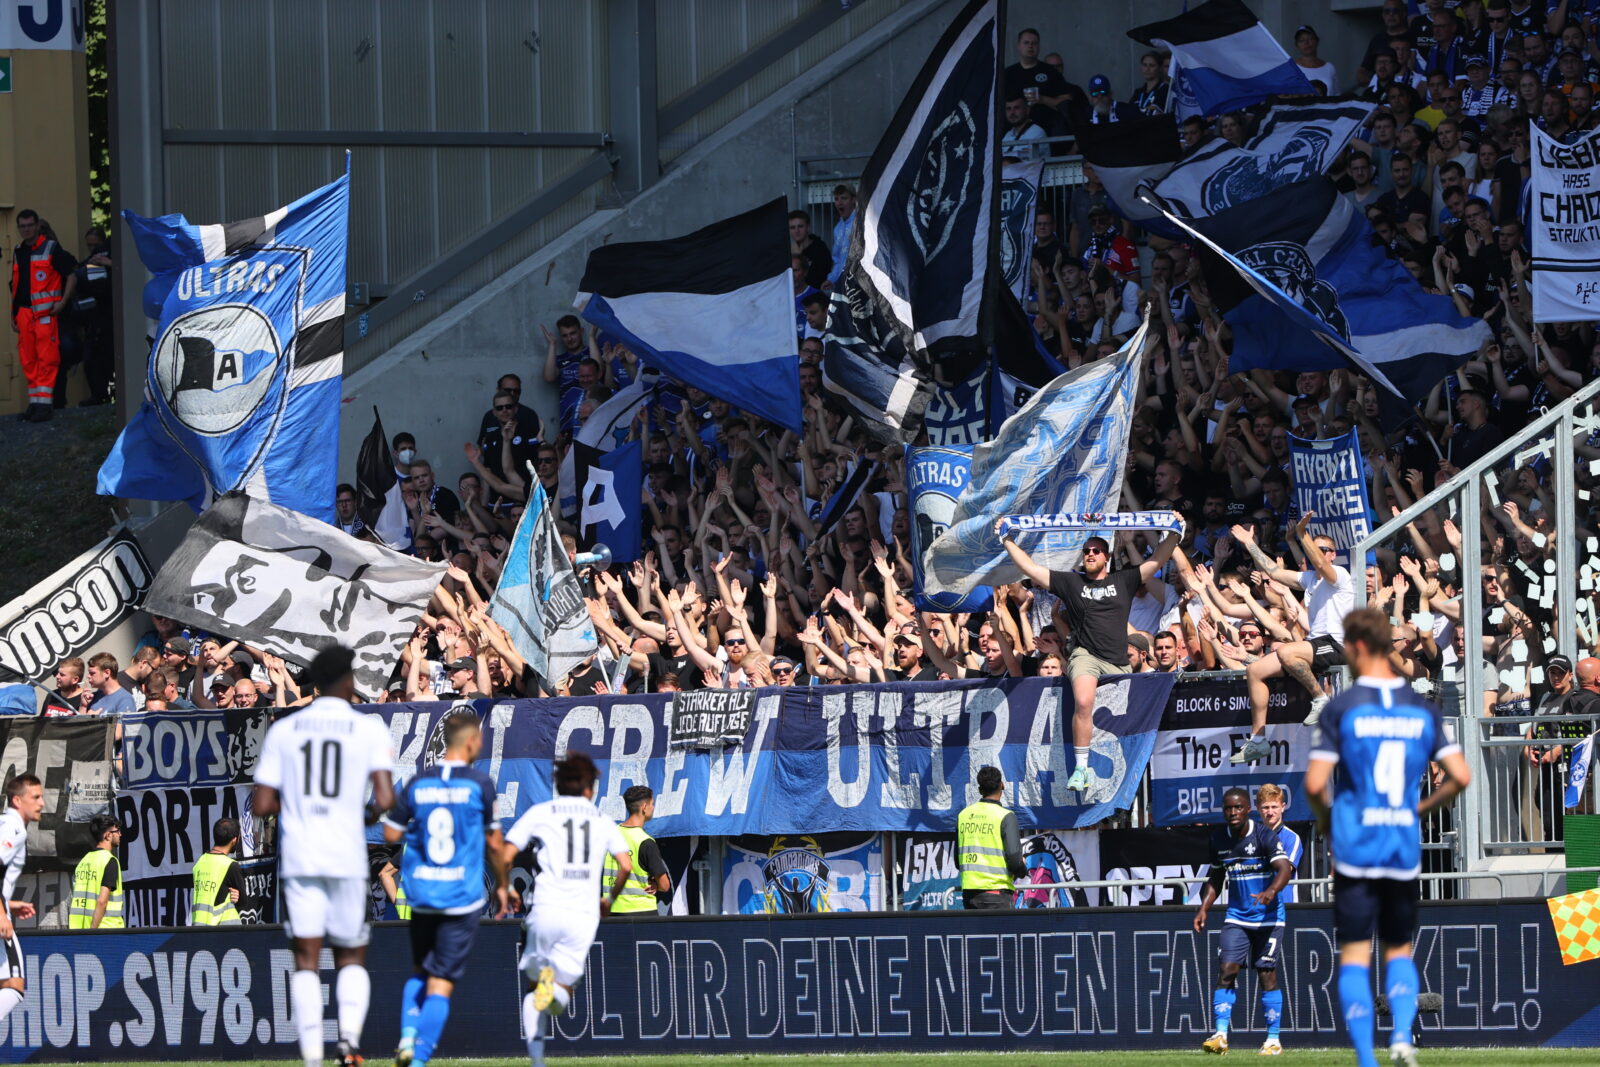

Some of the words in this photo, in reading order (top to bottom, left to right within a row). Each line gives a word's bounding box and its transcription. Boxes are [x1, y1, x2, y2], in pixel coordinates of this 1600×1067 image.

[1562, 172, 1591, 189] HASS
[177, 258, 286, 301] ULTRAS
[216, 352, 238, 381] A
[909, 461, 967, 490] ULTRAS
[1293, 447, 1359, 485] AVANTI
[1297, 483, 1365, 519] ULTRAS
[1004, 513, 1081, 529] LOKAL
[1103, 512, 1176, 528] CREW
[728, 691, 751, 711] ALS
[1176, 698, 1213, 712] BLOCK
[1214, 697, 1220, 711] 6
[1229, 696, 1252, 710] SINC
[1269, 693, 1288, 707] 998
[675, 714, 698, 734] JEDE
[699, 711, 749, 733] AUFLAGE
[125, 719, 227, 783] BOYS
[553, 694, 780, 821] CREW
[822, 678, 1131, 810] ULTRAS
[1176, 736, 1222, 770] The
[1229, 732, 1290, 767] Fm
[299, 738, 342, 798] 10
[1373, 740, 1406, 808] 4
[117, 786, 243, 872] PORTA
[427, 806, 456, 865] 8
[562, 818, 590, 864] 11
[960, 822, 994, 835] ORDNER
[75, 898, 87, 908] 15
[921, 892, 954, 908] ULTRS
[1268, 937, 1277, 957] 7
[0, 949, 339, 1047] HOP.SV98.DE
[636, 939, 731, 1039] DIR
[743, 936, 911, 1038] DEINE
[925, 931, 1119, 1036] NEUEN
